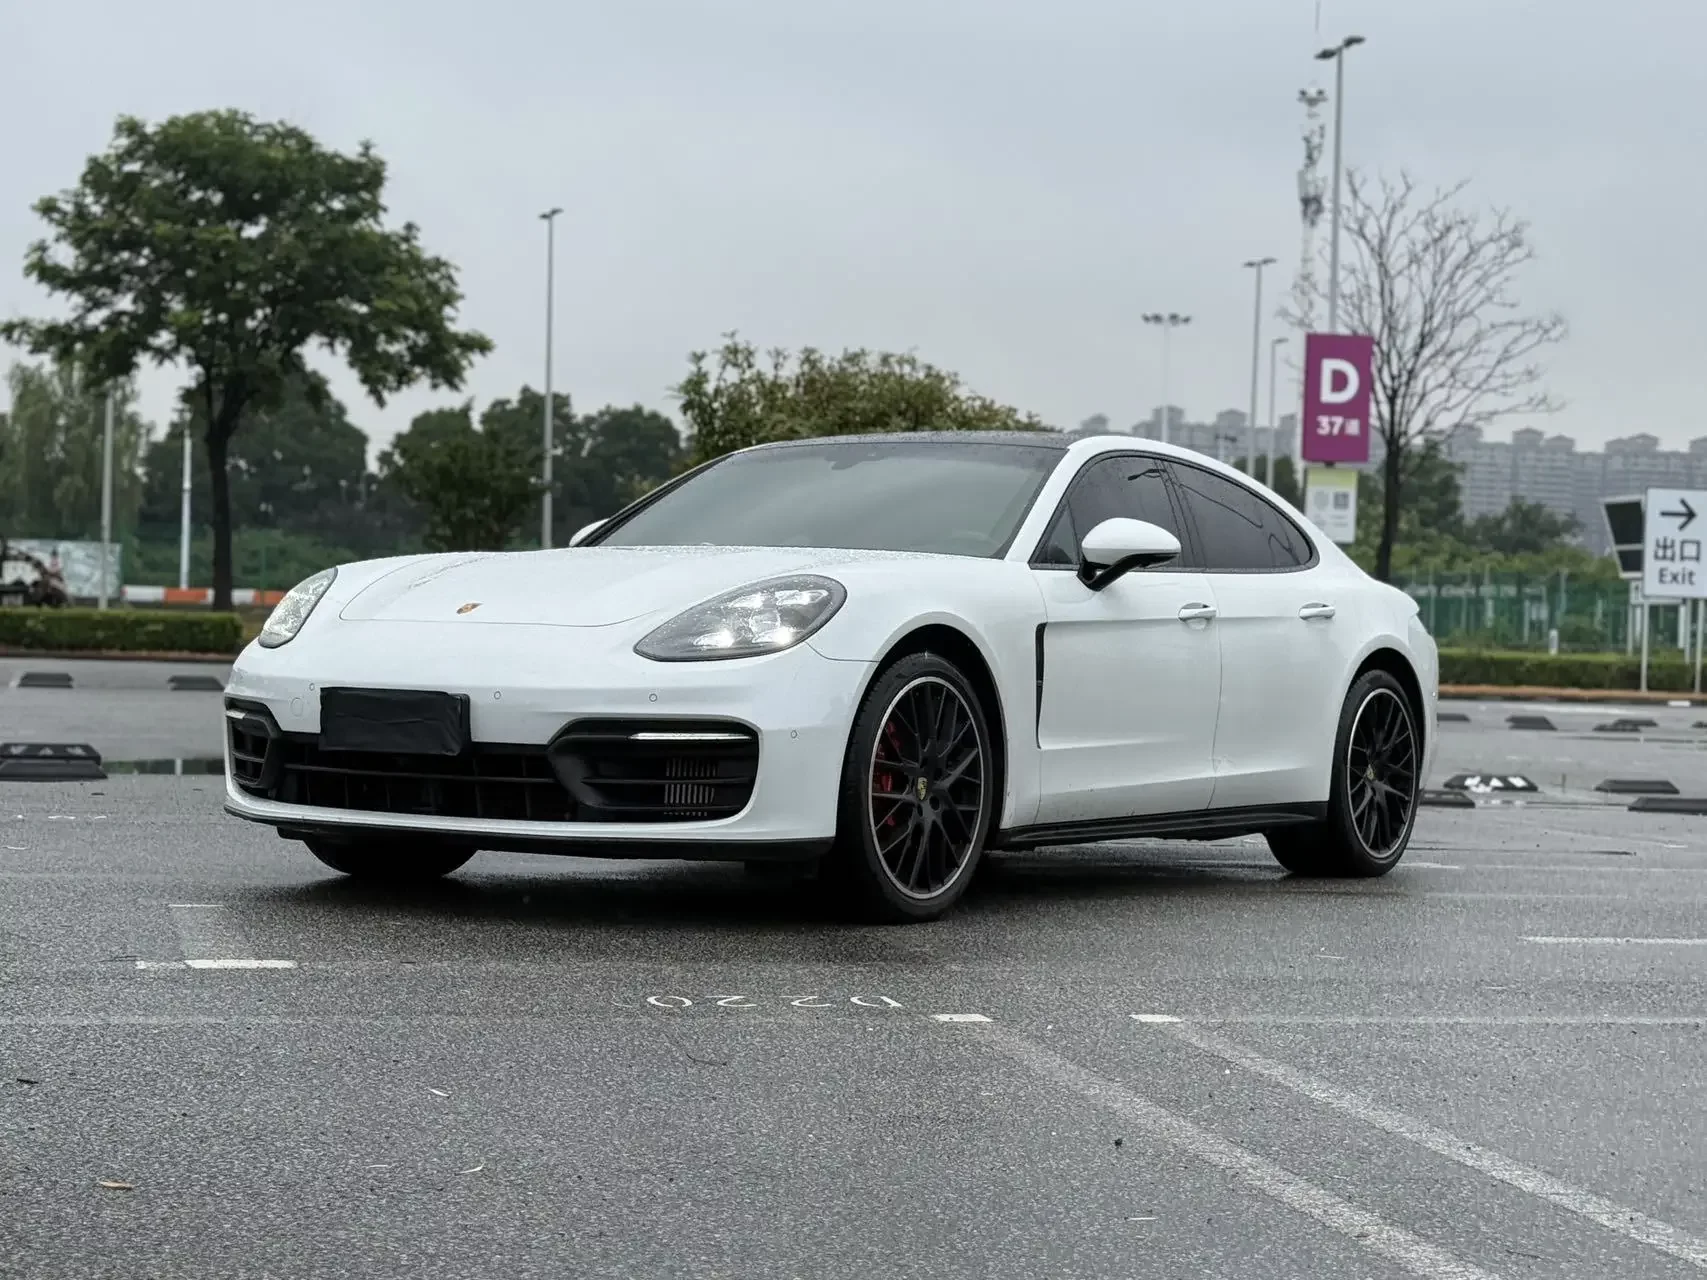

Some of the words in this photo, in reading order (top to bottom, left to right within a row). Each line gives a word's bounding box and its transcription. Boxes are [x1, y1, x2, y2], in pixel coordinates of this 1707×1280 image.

[1320, 358, 1360, 404] D
[1654, 536, 1701, 562] 出口
[1658, 567, 1696, 586] Exit
